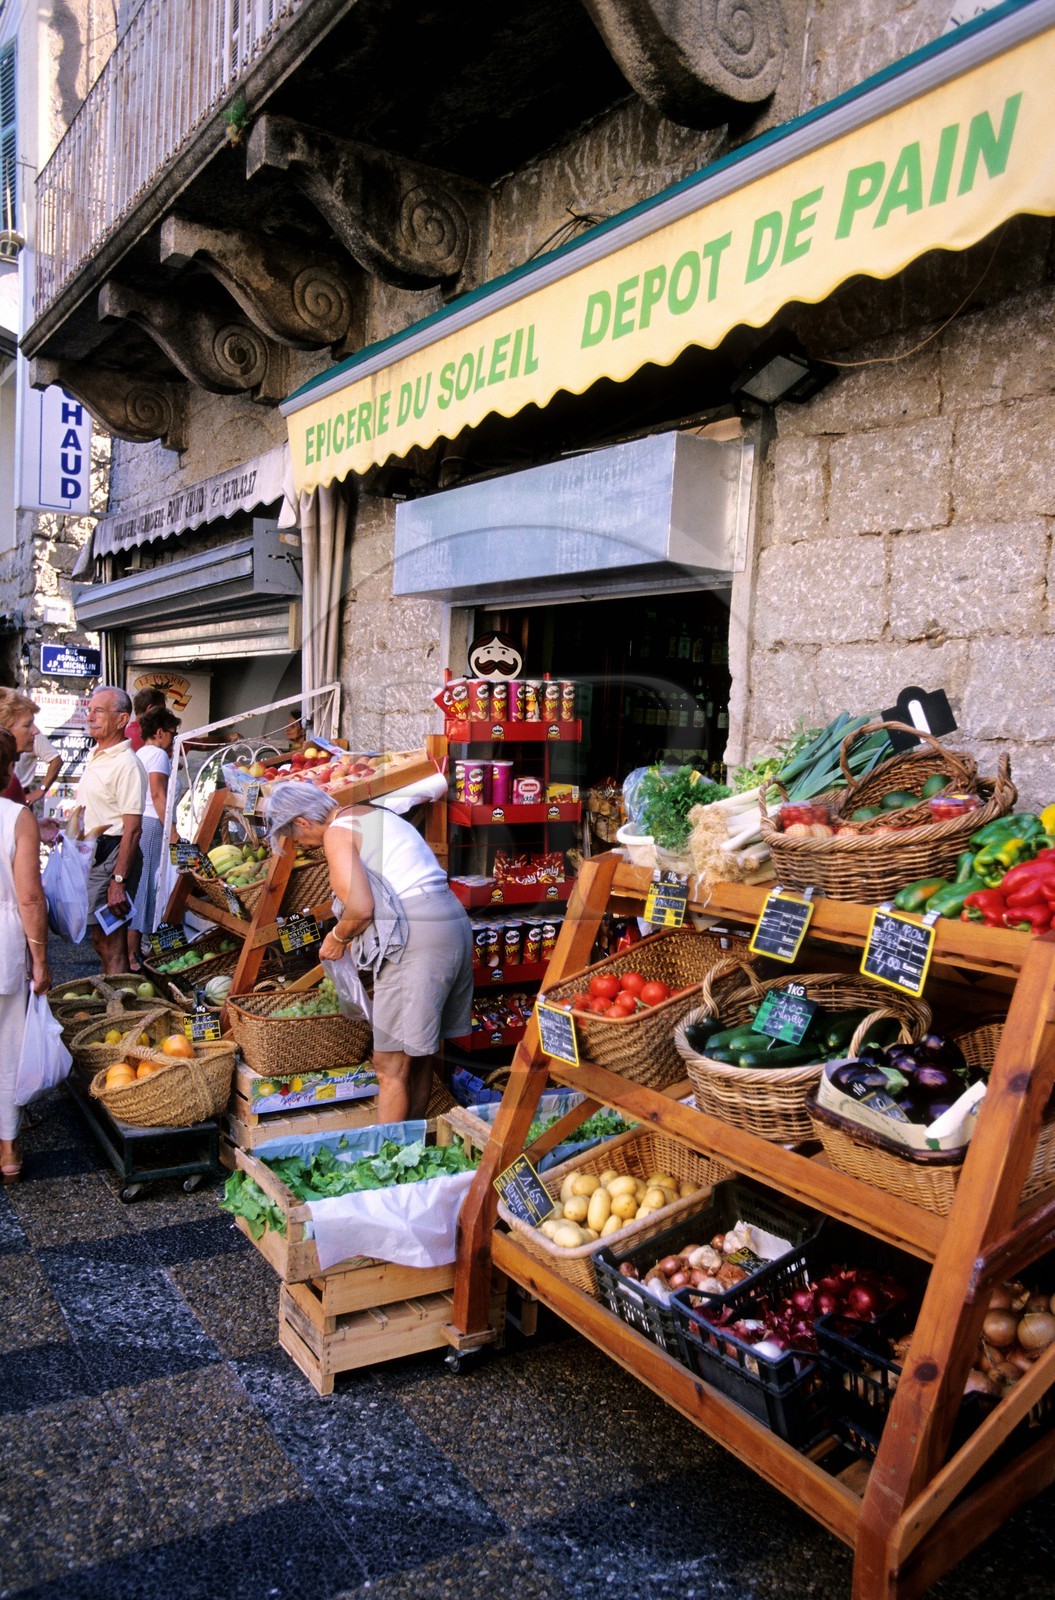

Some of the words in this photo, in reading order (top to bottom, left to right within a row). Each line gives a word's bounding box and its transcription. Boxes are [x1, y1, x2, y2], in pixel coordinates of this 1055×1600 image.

[305, 392, 391, 466] EPICERIE
[397, 373, 430, 427] DU
[437, 325, 539, 410] SOLEIL
[581, 231, 733, 348] DEPOT
[745, 188, 824, 283] DE
[835, 92, 1022, 240] PAIN
[63, 661, 96, 671] MICHELIN
[787, 982, 805, 997] 1KG
[898, 975, 919, 990] Francs
